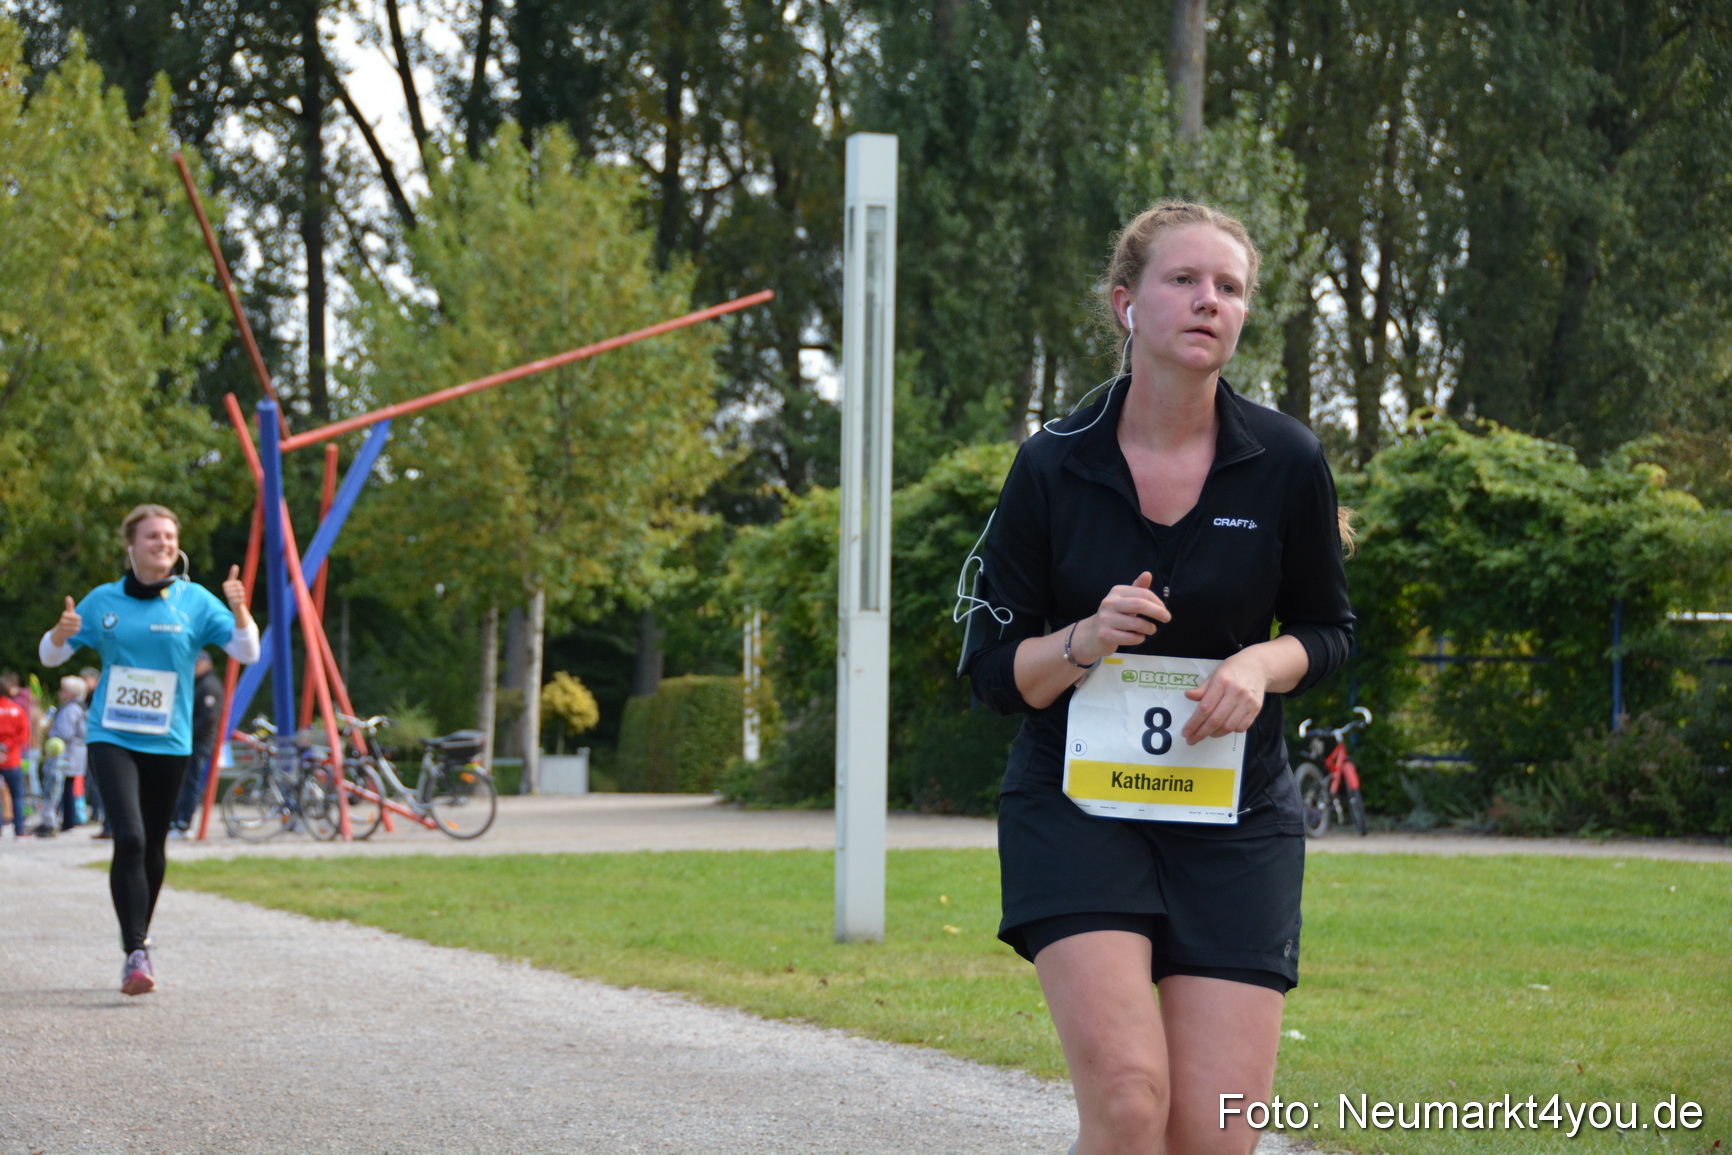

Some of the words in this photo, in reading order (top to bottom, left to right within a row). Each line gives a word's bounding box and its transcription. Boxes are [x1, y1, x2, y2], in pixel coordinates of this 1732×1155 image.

[1213, 517, 1249, 528] CRAFT
[1139, 670, 1199, 687] BOCK
[115, 686, 163, 709] 2368
[1141, 706, 1173, 756] 8
[1075, 743, 1082, 752] D
[1111, 770, 1194, 793] Katharina
